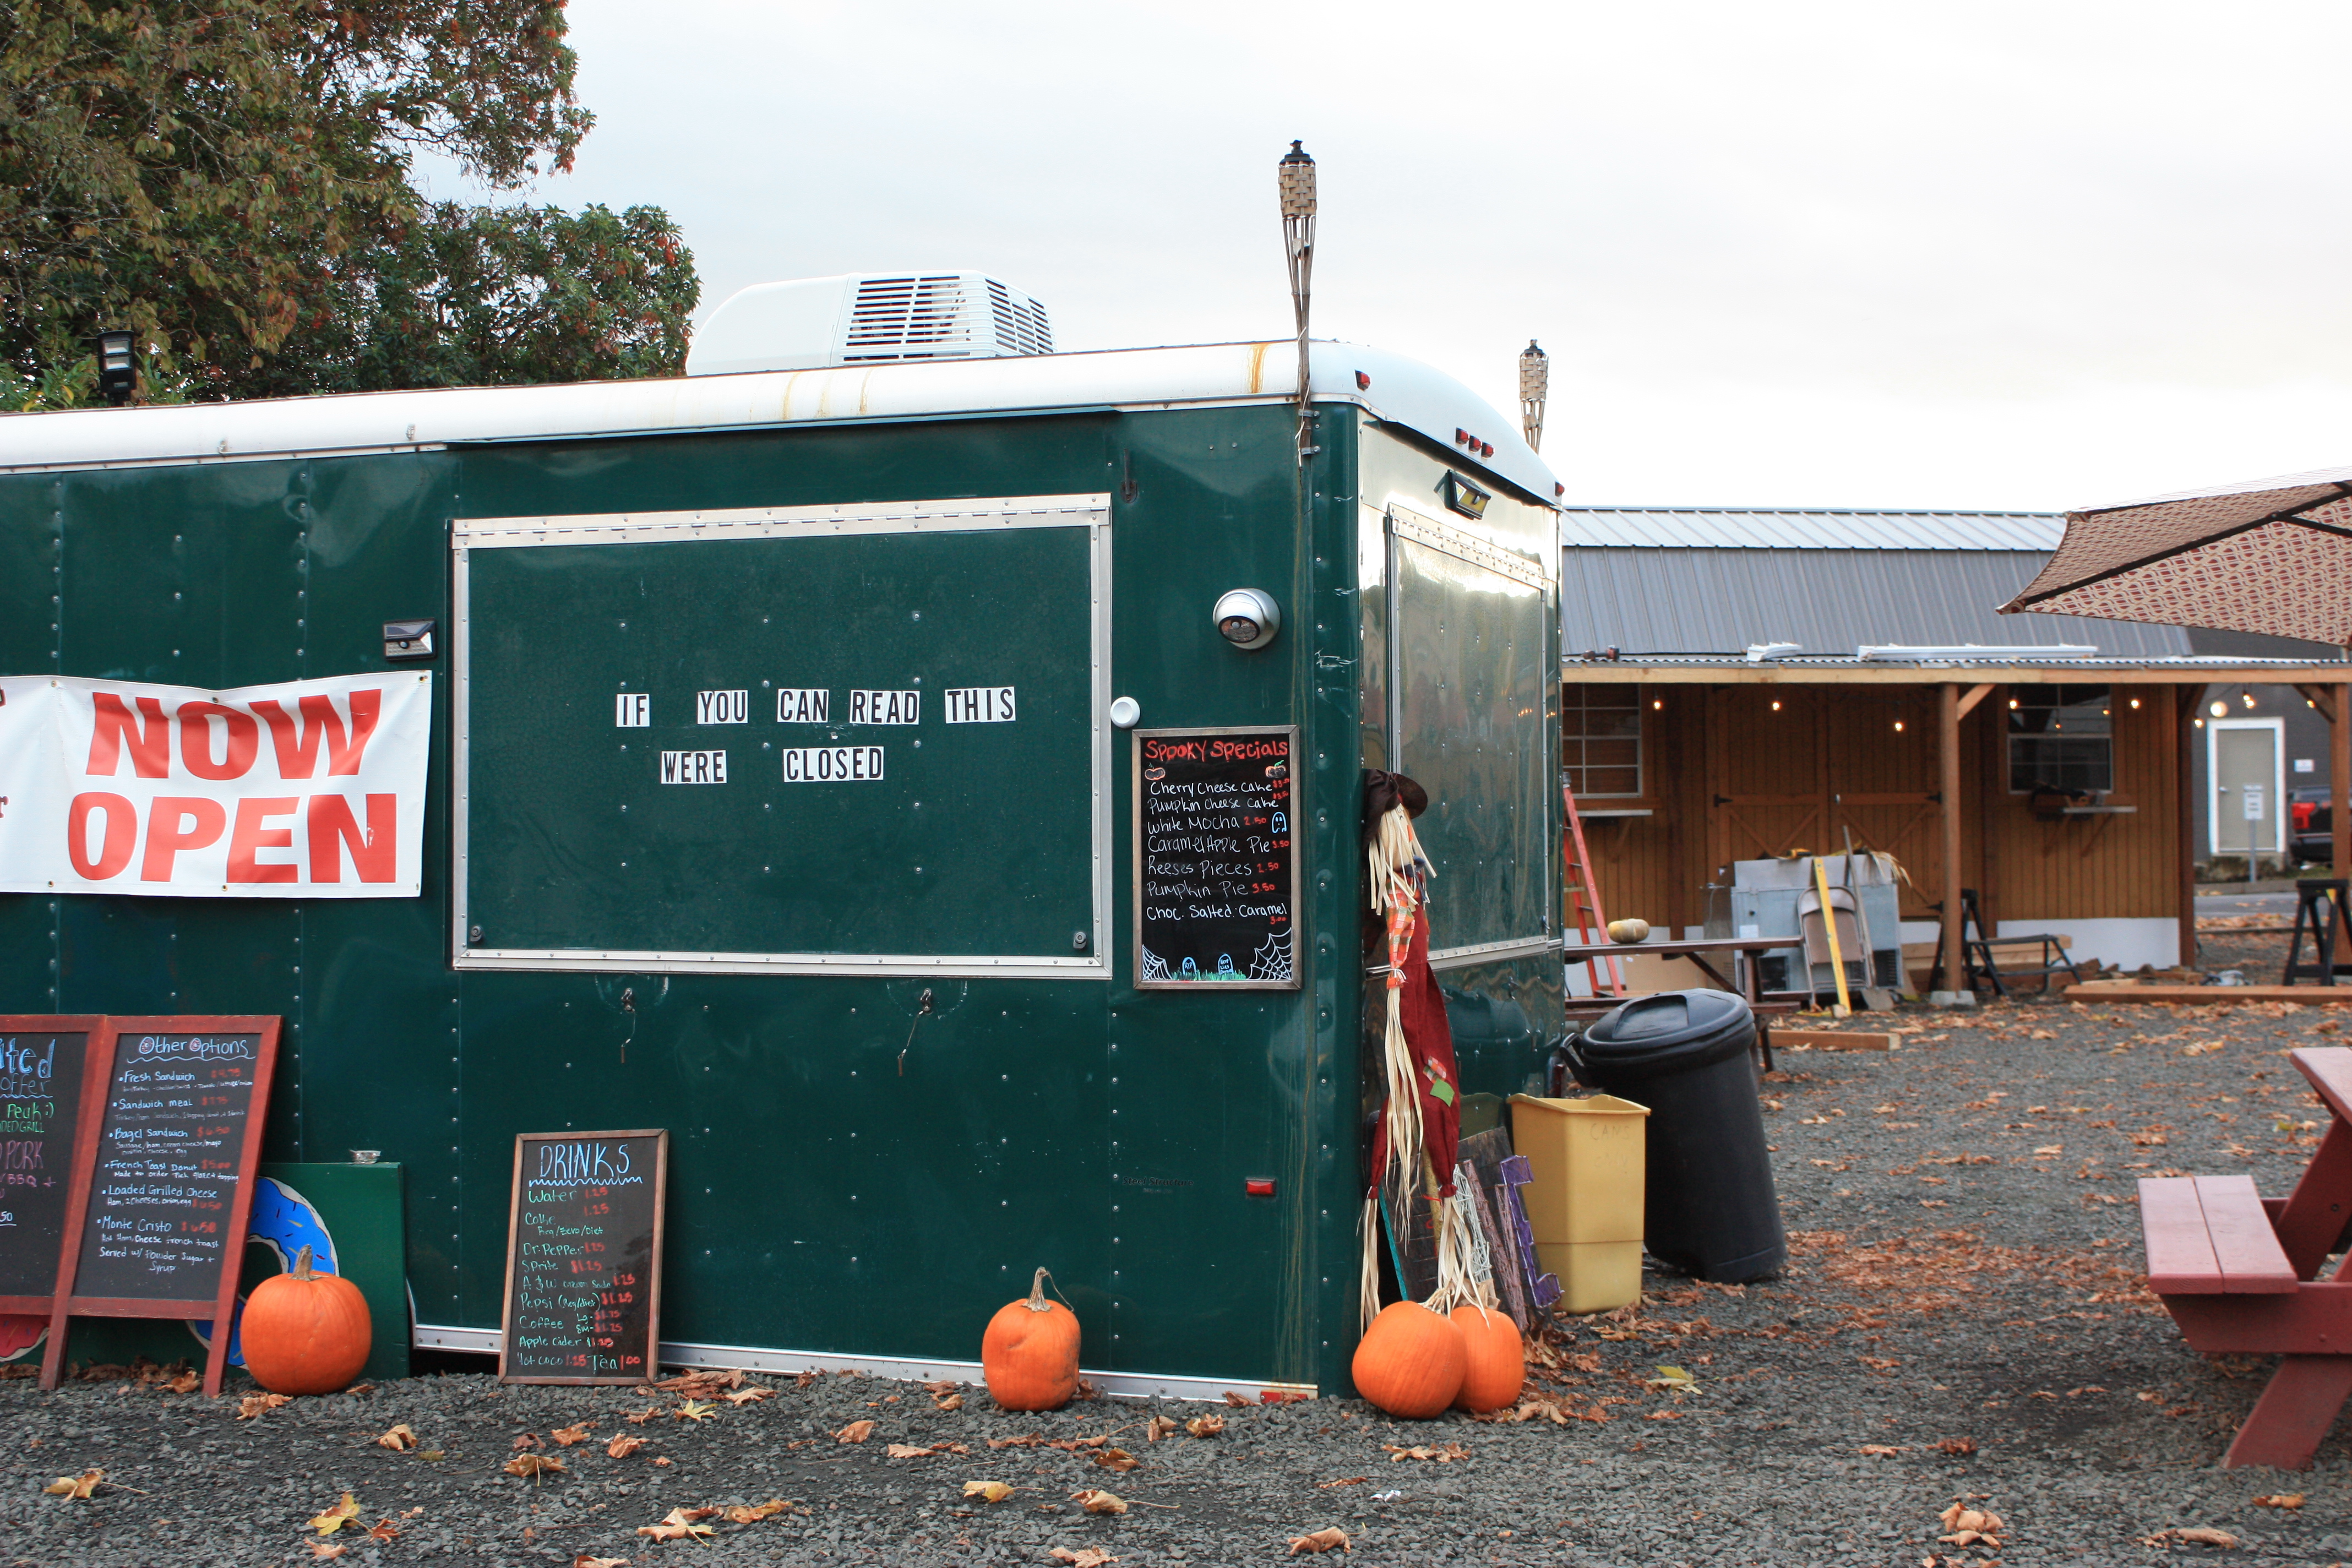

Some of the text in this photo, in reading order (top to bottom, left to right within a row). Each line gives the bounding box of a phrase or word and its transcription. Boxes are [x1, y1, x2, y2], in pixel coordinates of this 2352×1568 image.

[623, 688, 1014, 725] IF YOU CAN READ THIS
[85, 688, 382, 780] NOW
[662, 748, 883, 782] WERE CLOSED
[1150, 782, 1194, 797] Cherry
[1147, 797, 1201, 815] Pumpkin
[1188, 815, 1240, 830] Mocha
[1243, 816, 1267, 826] 2.50
[67, 791, 397, 883] OPEN
[1148, 835, 1205, 853] Caramel
[1207, 834, 1241, 853] Apple
[1246, 836, 1270, 854] Pie
[1148, 855, 1194, 876] Reeses
[1199, 860, 1253, 879] Pieces
[1146, 880, 1275, 900] Pumpkin Pie 3.50
[1238, 902, 1287, 917] Caramel
[139, 1036, 249, 1058] Other Options
[1, 1073, 51, 1095] offer
[124, 1070, 151, 1083] Fresh
[155, 1071, 195, 1081] Sandwich
[119, 1098, 164, 1110] Sandwich
[115, 1127, 143, 1142] Bagel
[146, 1128, 188, 1138] Sandwich
[1590, 1123, 1630, 1140] CANS
[6, 1140, 43, 1169] PORK
[540, 1142, 630, 1179] DRINKS
[110, 1159, 143, 1169] French
[144, 1159, 167, 1170] Toast
[1123, 1176, 1194, 1186] Steel Structure
[109, 1184, 217, 1198] Loaded Grilled Cheese
[528, 1186, 608, 1203] Water 1.25
[583, 1203, 610, 1216] 1.25
[101, 1215, 133, 1229] Monte
[138, 1218, 172, 1232] Cristo
[135, 1234, 162, 1243] Cheese
[196, 1239, 219, 1248] toast
[99, 1246, 127, 1257] Served
[182, 1252, 204, 1266] Sugar
[149, 1261, 176, 1275] Syrup
[521, 1260, 558, 1273] Sprite
[520, 1292, 553, 1313] Pepsi
[519, 1315, 564, 1329] Coffee
[519, 1335, 548, 1349] Apple
[586, 1354, 618, 1374] Tea
